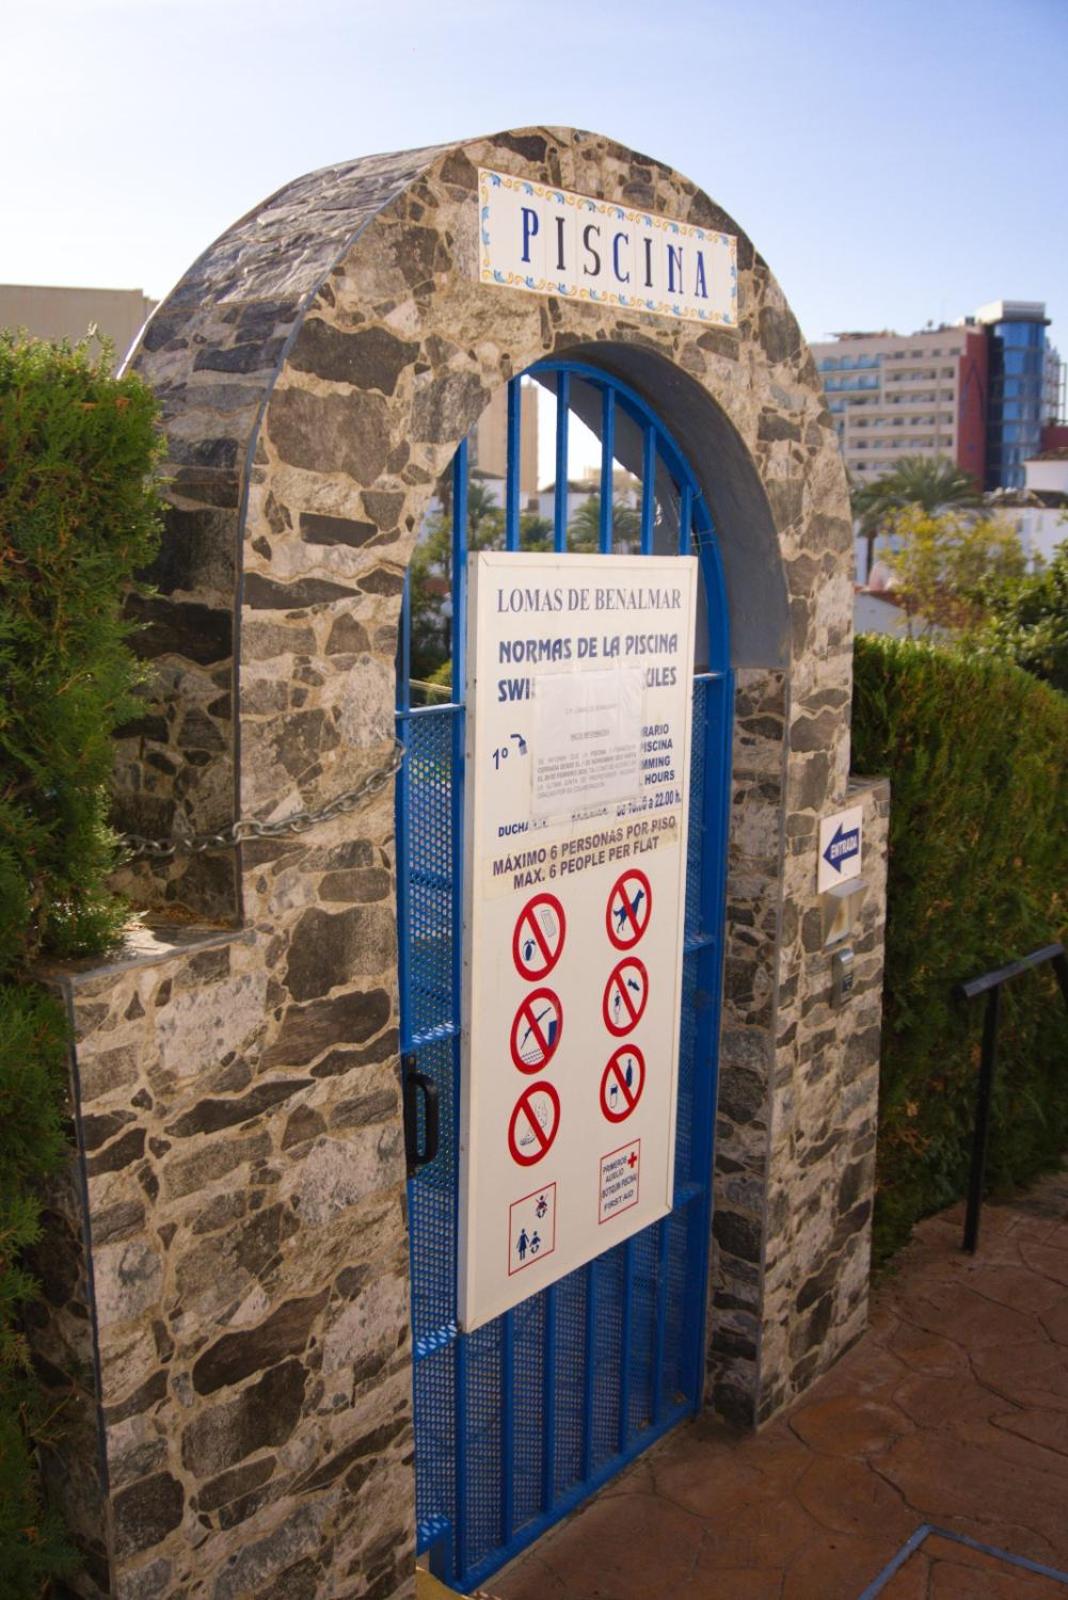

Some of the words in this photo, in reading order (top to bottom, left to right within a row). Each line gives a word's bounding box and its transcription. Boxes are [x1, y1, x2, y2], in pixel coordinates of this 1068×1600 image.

[521, 207, 708, 298] PISCINA
[497, 588, 563, 613] LOMAS
[568, 588, 590, 611] DE
[595, 588, 681, 611] BENALMAR
[499, 638, 572, 664] NORMAS
[577, 637, 597, 659] DE
[603, 636, 620, 658] LA
[625, 633, 678, 655] PISCINA
[498, 677, 535, 703] SWI
[645, 666, 677, 689] ULES
[641, 723, 670, 737] RARIO
[641, 738, 673, 753] ISCINA
[641, 755, 671, 769] MMING
[644, 770, 675, 785] HOURS
[654, 790, 674, 808] 22.00
[493, 848, 546, 876] MÁXIMO
[551, 844, 558, 860] 6
[561, 829, 623, 857] PERSONAS
[626, 821, 649, 837] POR
[651, 815, 677, 831] PISO
[513, 866, 546, 889] MAX.
[550, 862, 557, 878] 6
[560, 851, 606, 876] PEOPLE
[608, 842, 631, 862] PER
[633, 836, 660, 853] FLAT
